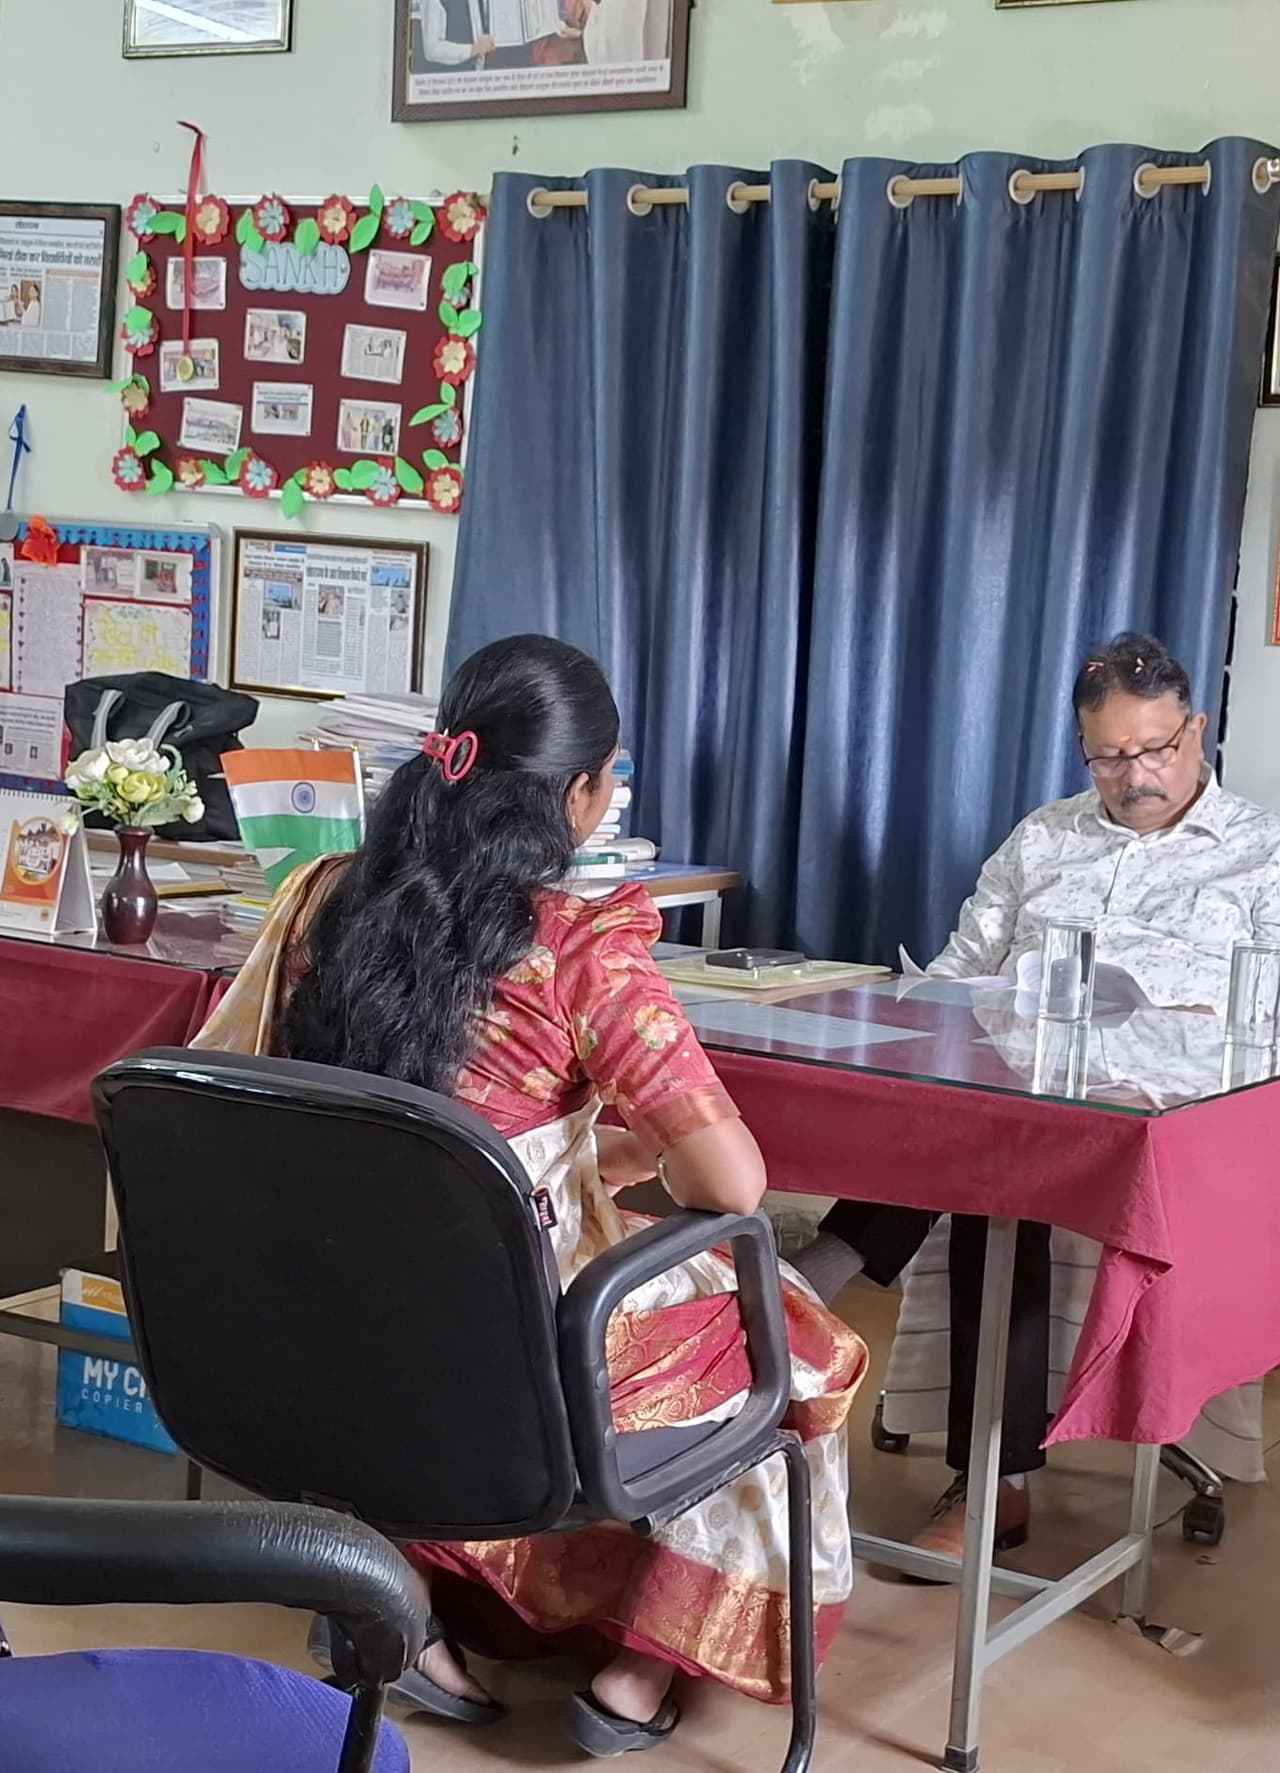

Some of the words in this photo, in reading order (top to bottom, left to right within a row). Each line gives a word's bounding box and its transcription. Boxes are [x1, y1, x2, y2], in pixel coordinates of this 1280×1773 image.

[246, 246, 338, 287] SANKH
[83, 1355, 119, 1390] MY
[82, 1388, 143, 1414] COPIER
